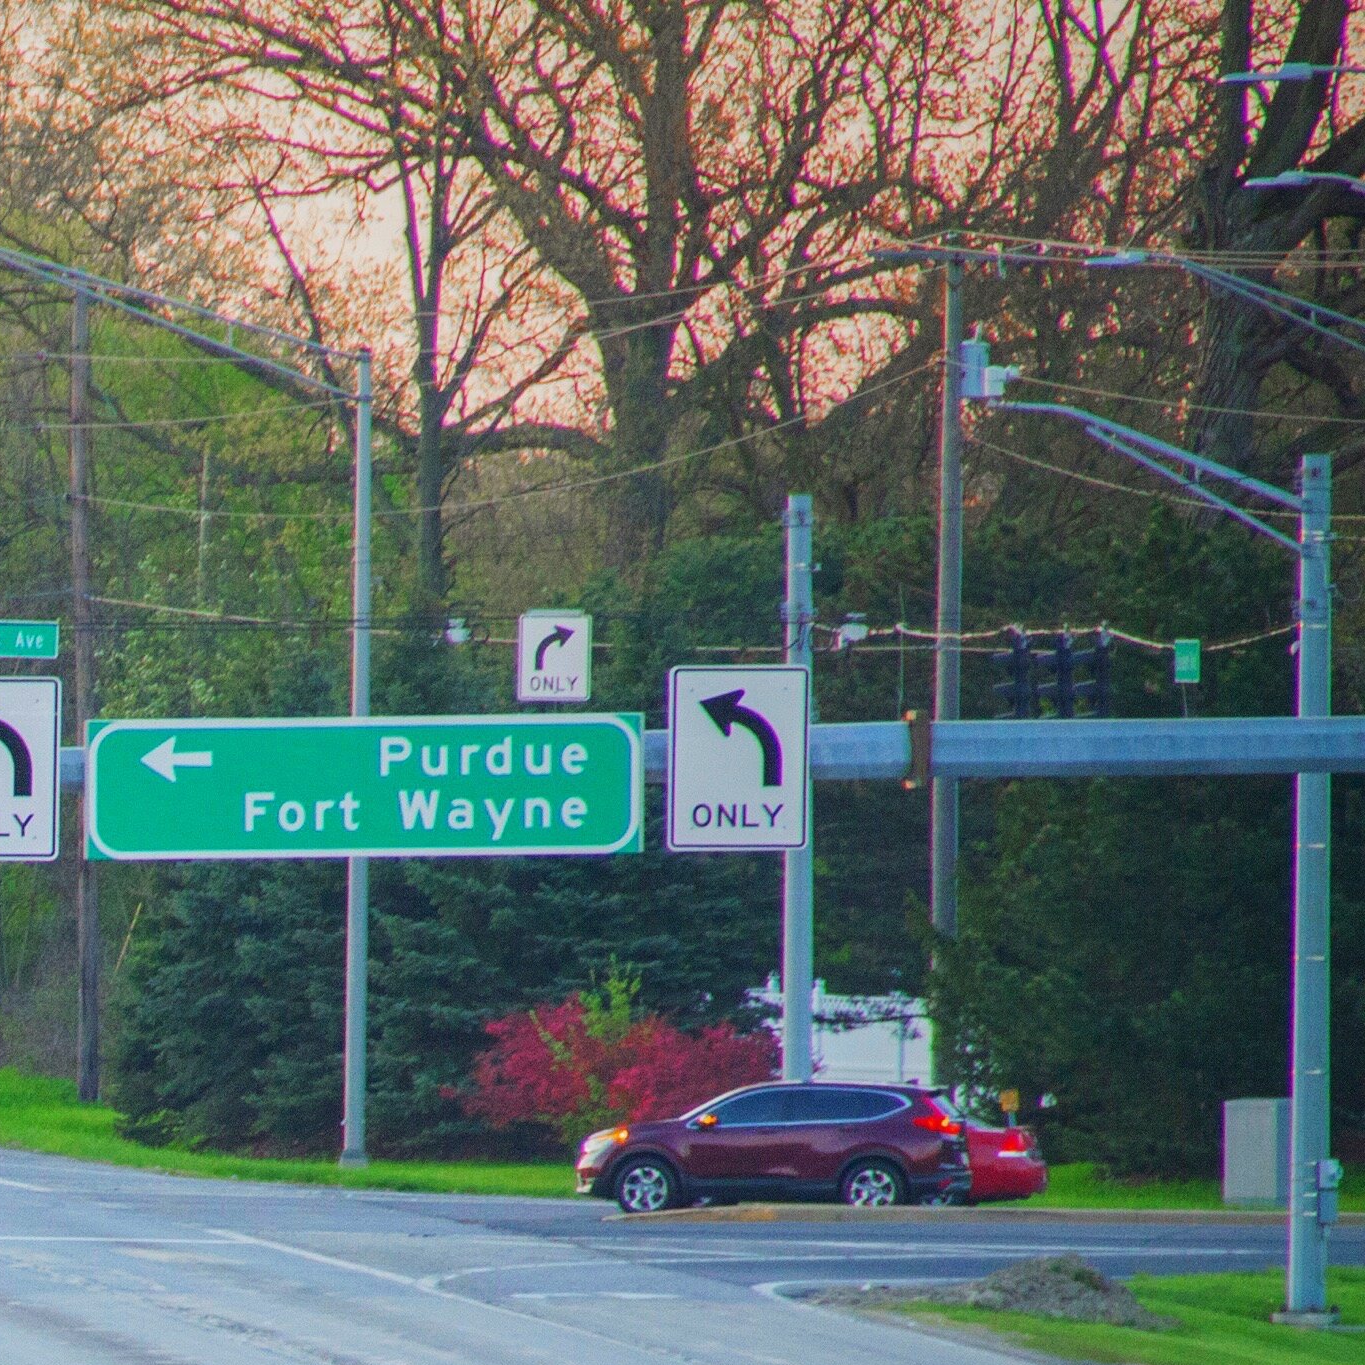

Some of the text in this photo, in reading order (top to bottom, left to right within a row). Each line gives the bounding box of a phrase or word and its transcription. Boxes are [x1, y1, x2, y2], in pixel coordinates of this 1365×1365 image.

[14, 630, 44, 650] Ave
[530, 675, 579, 693] ONLY
[379, 735, 589, 778] Purdue
[243, 789, 589, 842] Fort Wayne
[692, 802, 785, 829] ONLY
